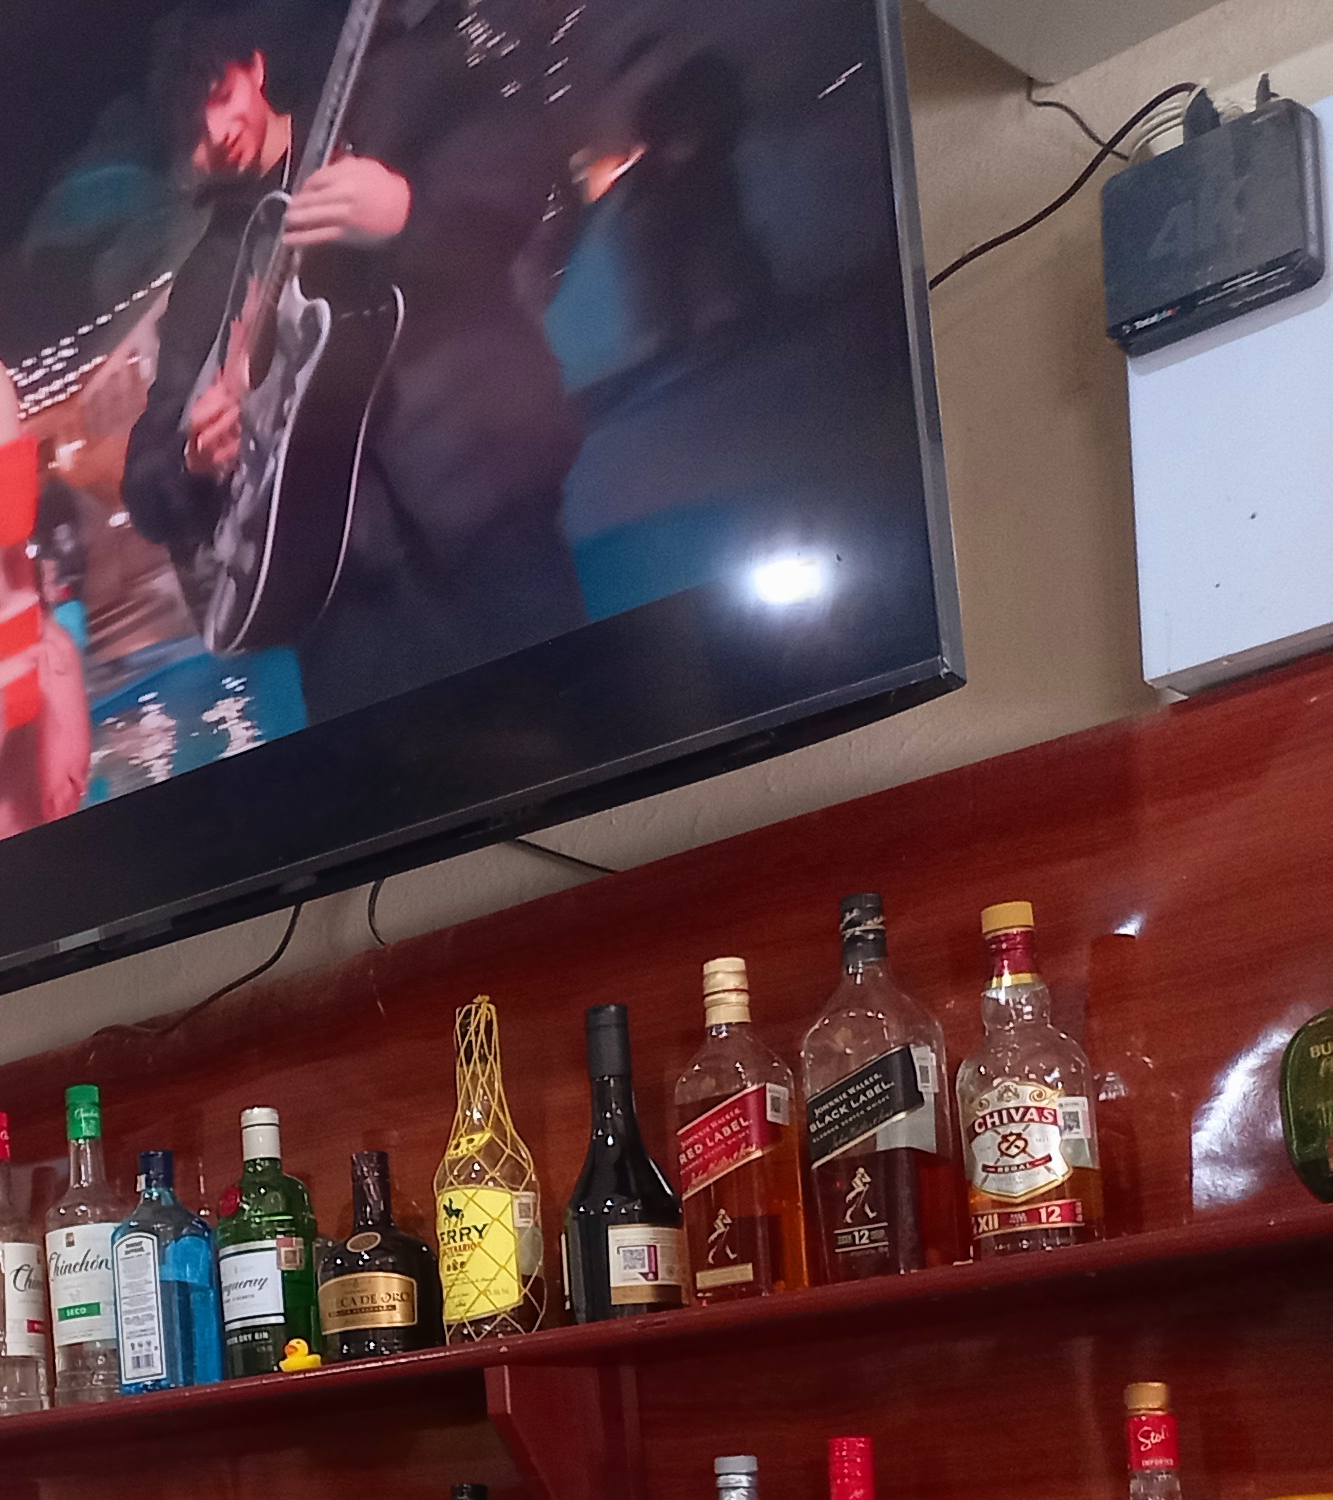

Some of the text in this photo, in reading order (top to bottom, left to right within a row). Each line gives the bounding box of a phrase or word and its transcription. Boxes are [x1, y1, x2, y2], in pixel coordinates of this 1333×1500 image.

[809, 1103, 850, 1133] BLACK
[974, 1107, 1054, 1133] CHIVAS
[678, 1143, 703, 1165] RED
[997, 1162, 1032, 1173] REGAL
[978, 1213, 999, 1233] XII
[1039, 1205, 1062, 1223] 12
[853, 1229, 870, 1245] 12
[381, 1291, 410, 1303] ORO
